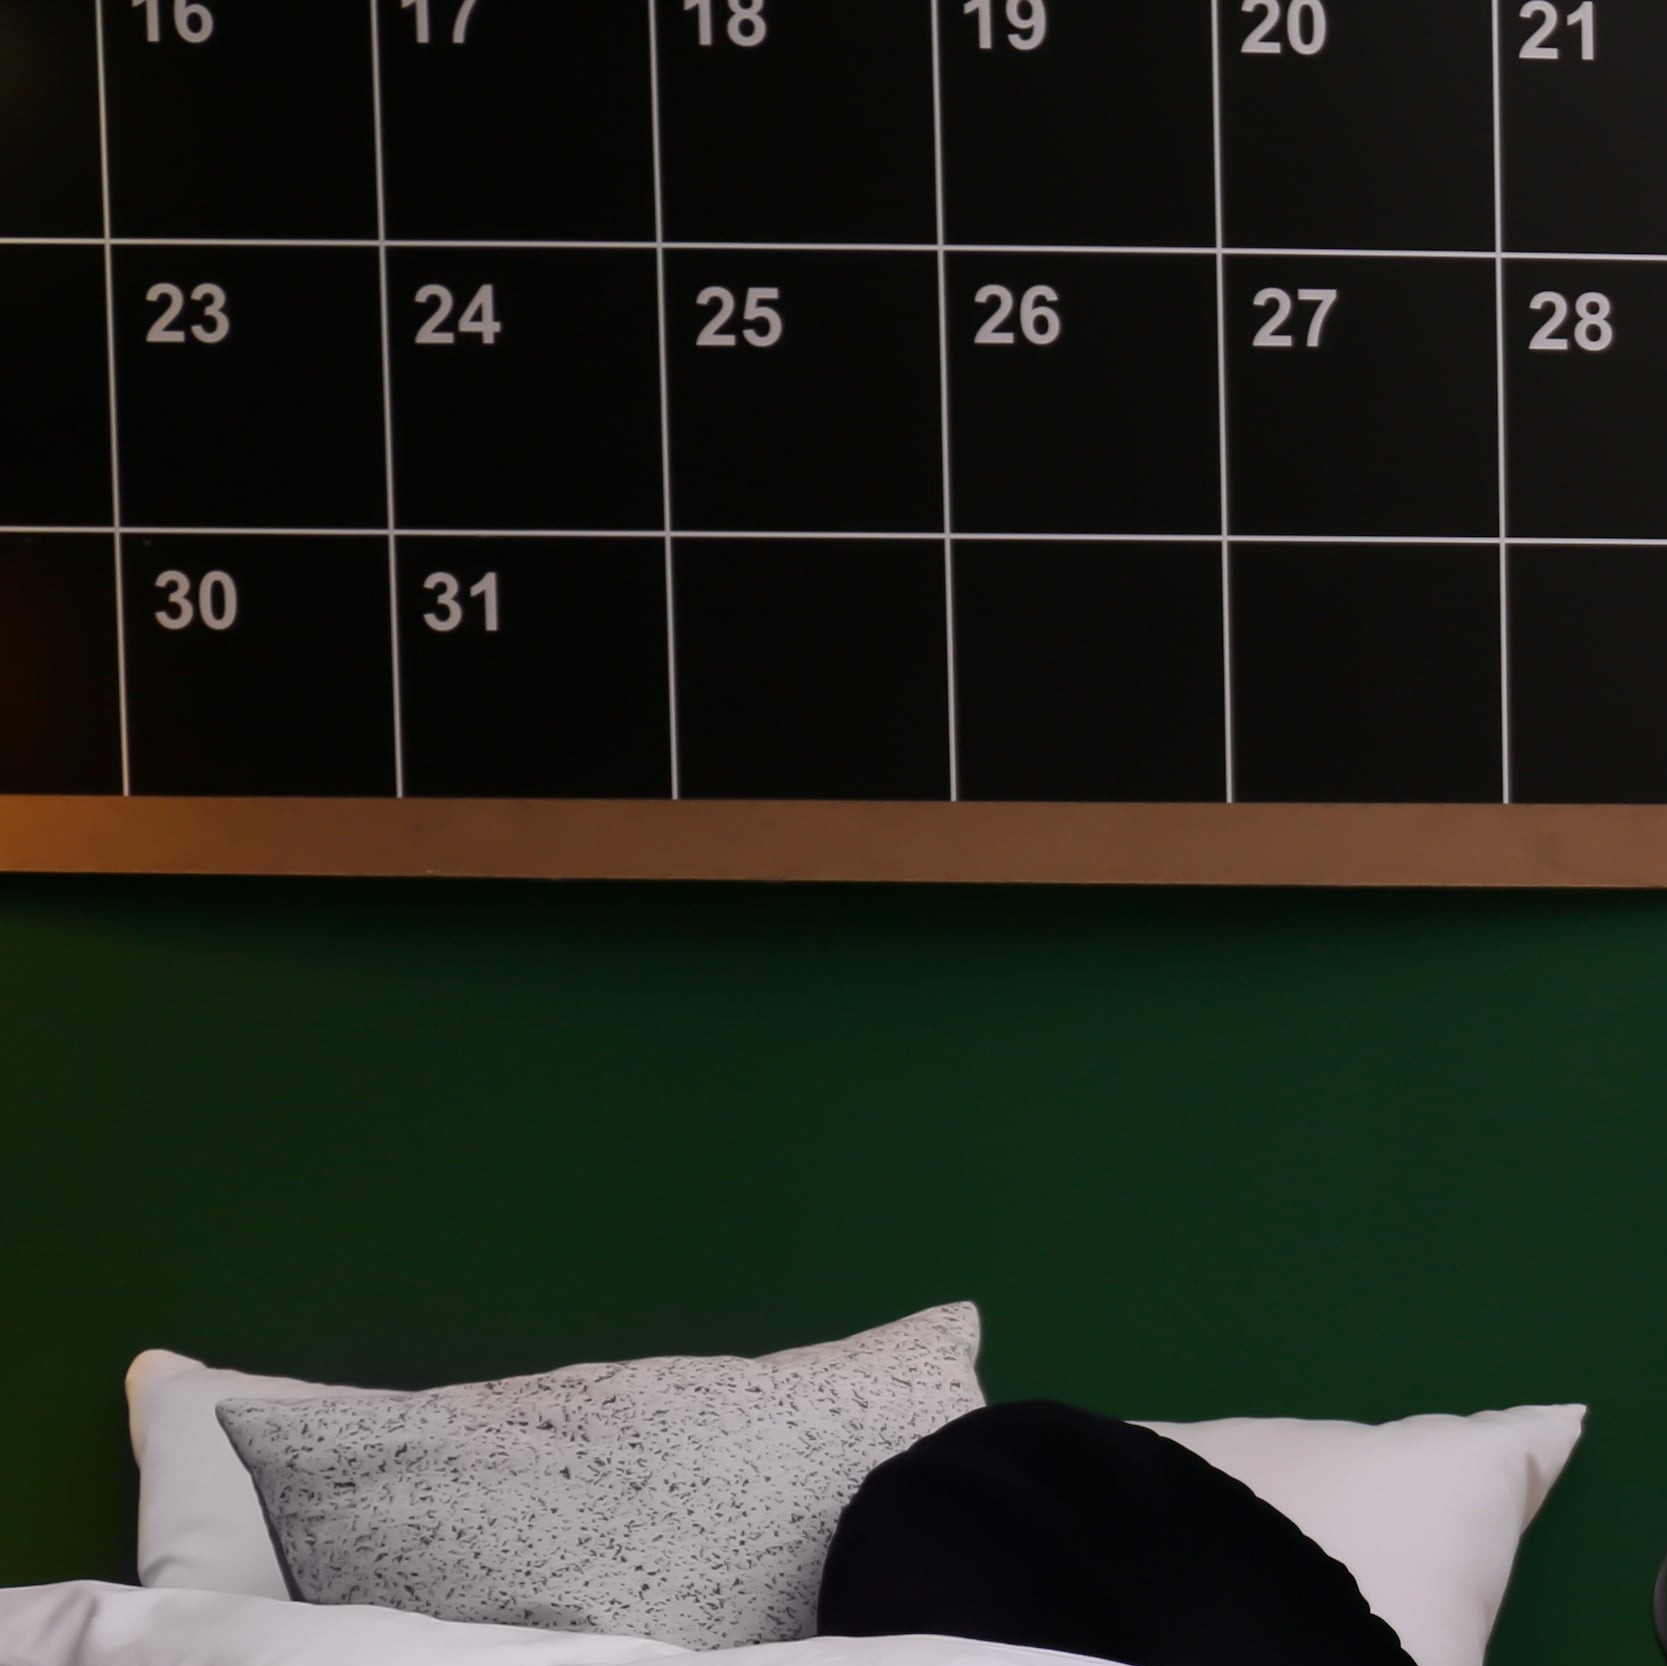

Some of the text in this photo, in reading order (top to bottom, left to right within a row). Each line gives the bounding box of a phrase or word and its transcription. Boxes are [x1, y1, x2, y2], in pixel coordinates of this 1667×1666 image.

[131, 0, 214, 43] 16
[684, 0, 768, 47] 18
[963, 0, 1048, 51] 19
[1240, 0, 1328, 55] 20
[1518, 0, 1596, 61] 21
[146, 283, 231, 343] 23
[414, 284, 501, 344] 24
[696, 286, 783, 347] 25
[974, 284, 1062, 344] 26
[1252, 287, 1338, 348] 27
[1528, 291, 1614, 352] 28
[154, 570, 238, 630] 30
[422, 572, 499, 632] 31
